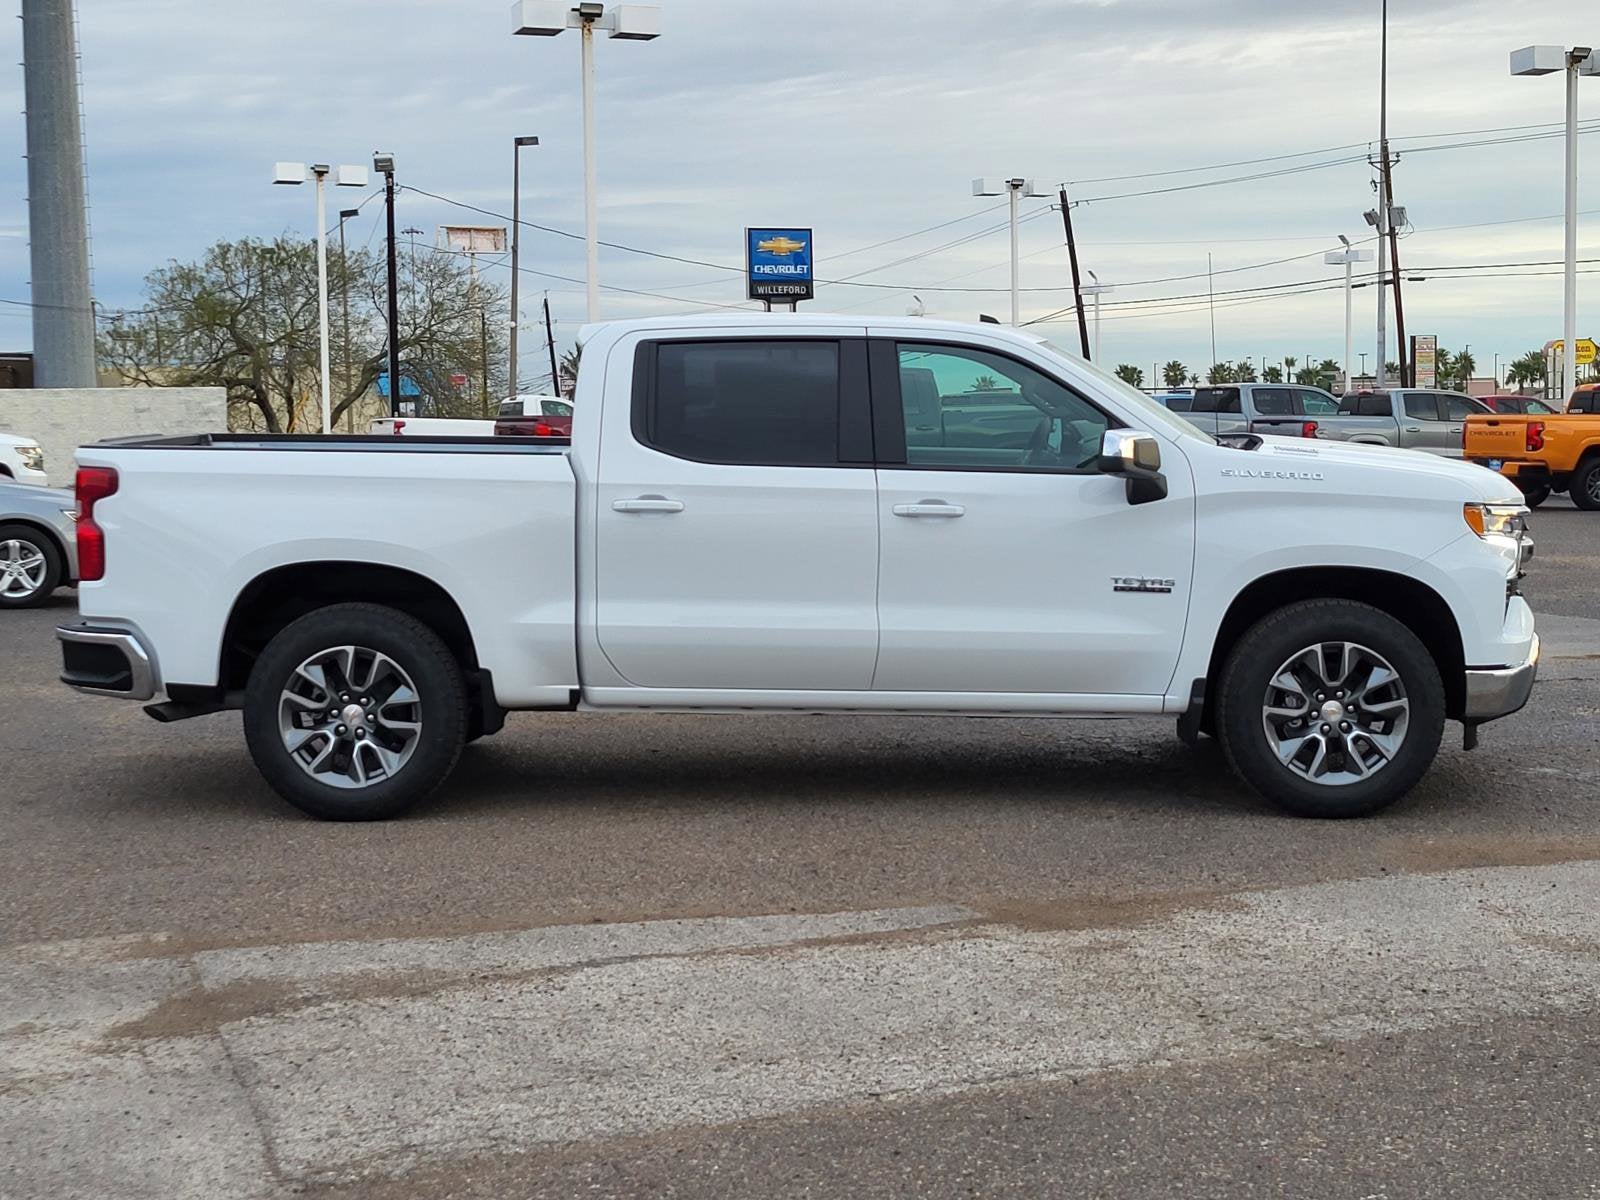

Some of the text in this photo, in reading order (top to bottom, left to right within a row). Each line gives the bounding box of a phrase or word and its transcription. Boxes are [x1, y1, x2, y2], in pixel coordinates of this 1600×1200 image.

[754, 264, 809, 274] CHEVROLET
[757, 285, 807, 294] WILLEFORD
[1220, 468, 1324, 481] SILVERADO
